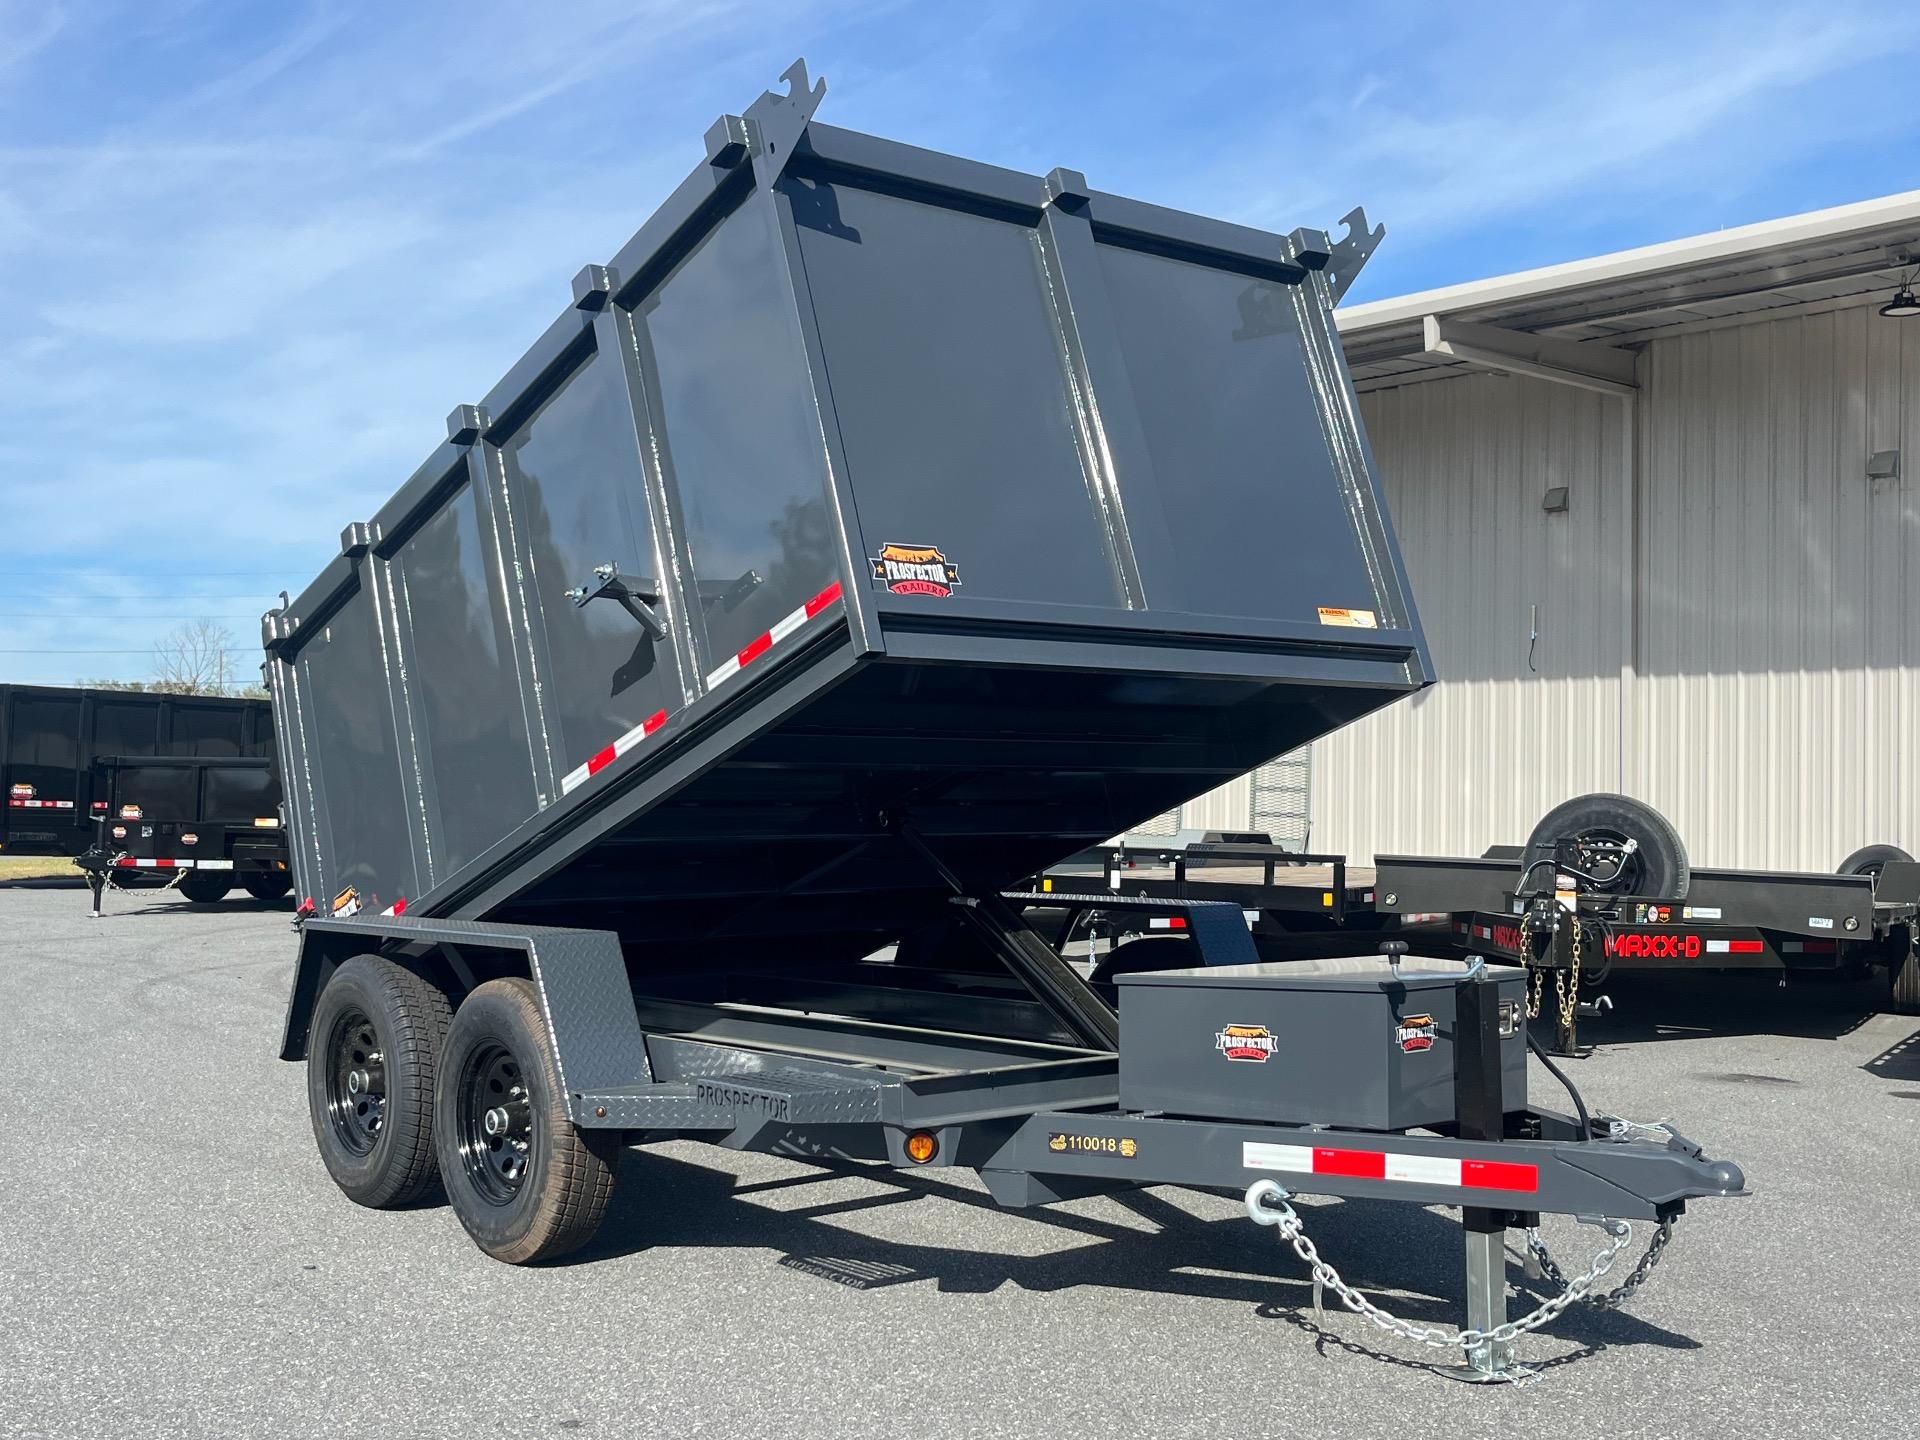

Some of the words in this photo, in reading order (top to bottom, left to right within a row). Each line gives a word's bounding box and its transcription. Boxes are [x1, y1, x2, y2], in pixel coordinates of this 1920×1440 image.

[883, 560, 948, 584] PROSPECTOR
[896, 583, 944, 596] TRAILERS
[1604, 934, 1702, 958] MAXX-D
[1220, 1034, 1274, 1050] PROSPECTOR
[697, 1084, 788, 1121] PROSPECTOR
[1069, 1135, 1116, 1152] 110018
